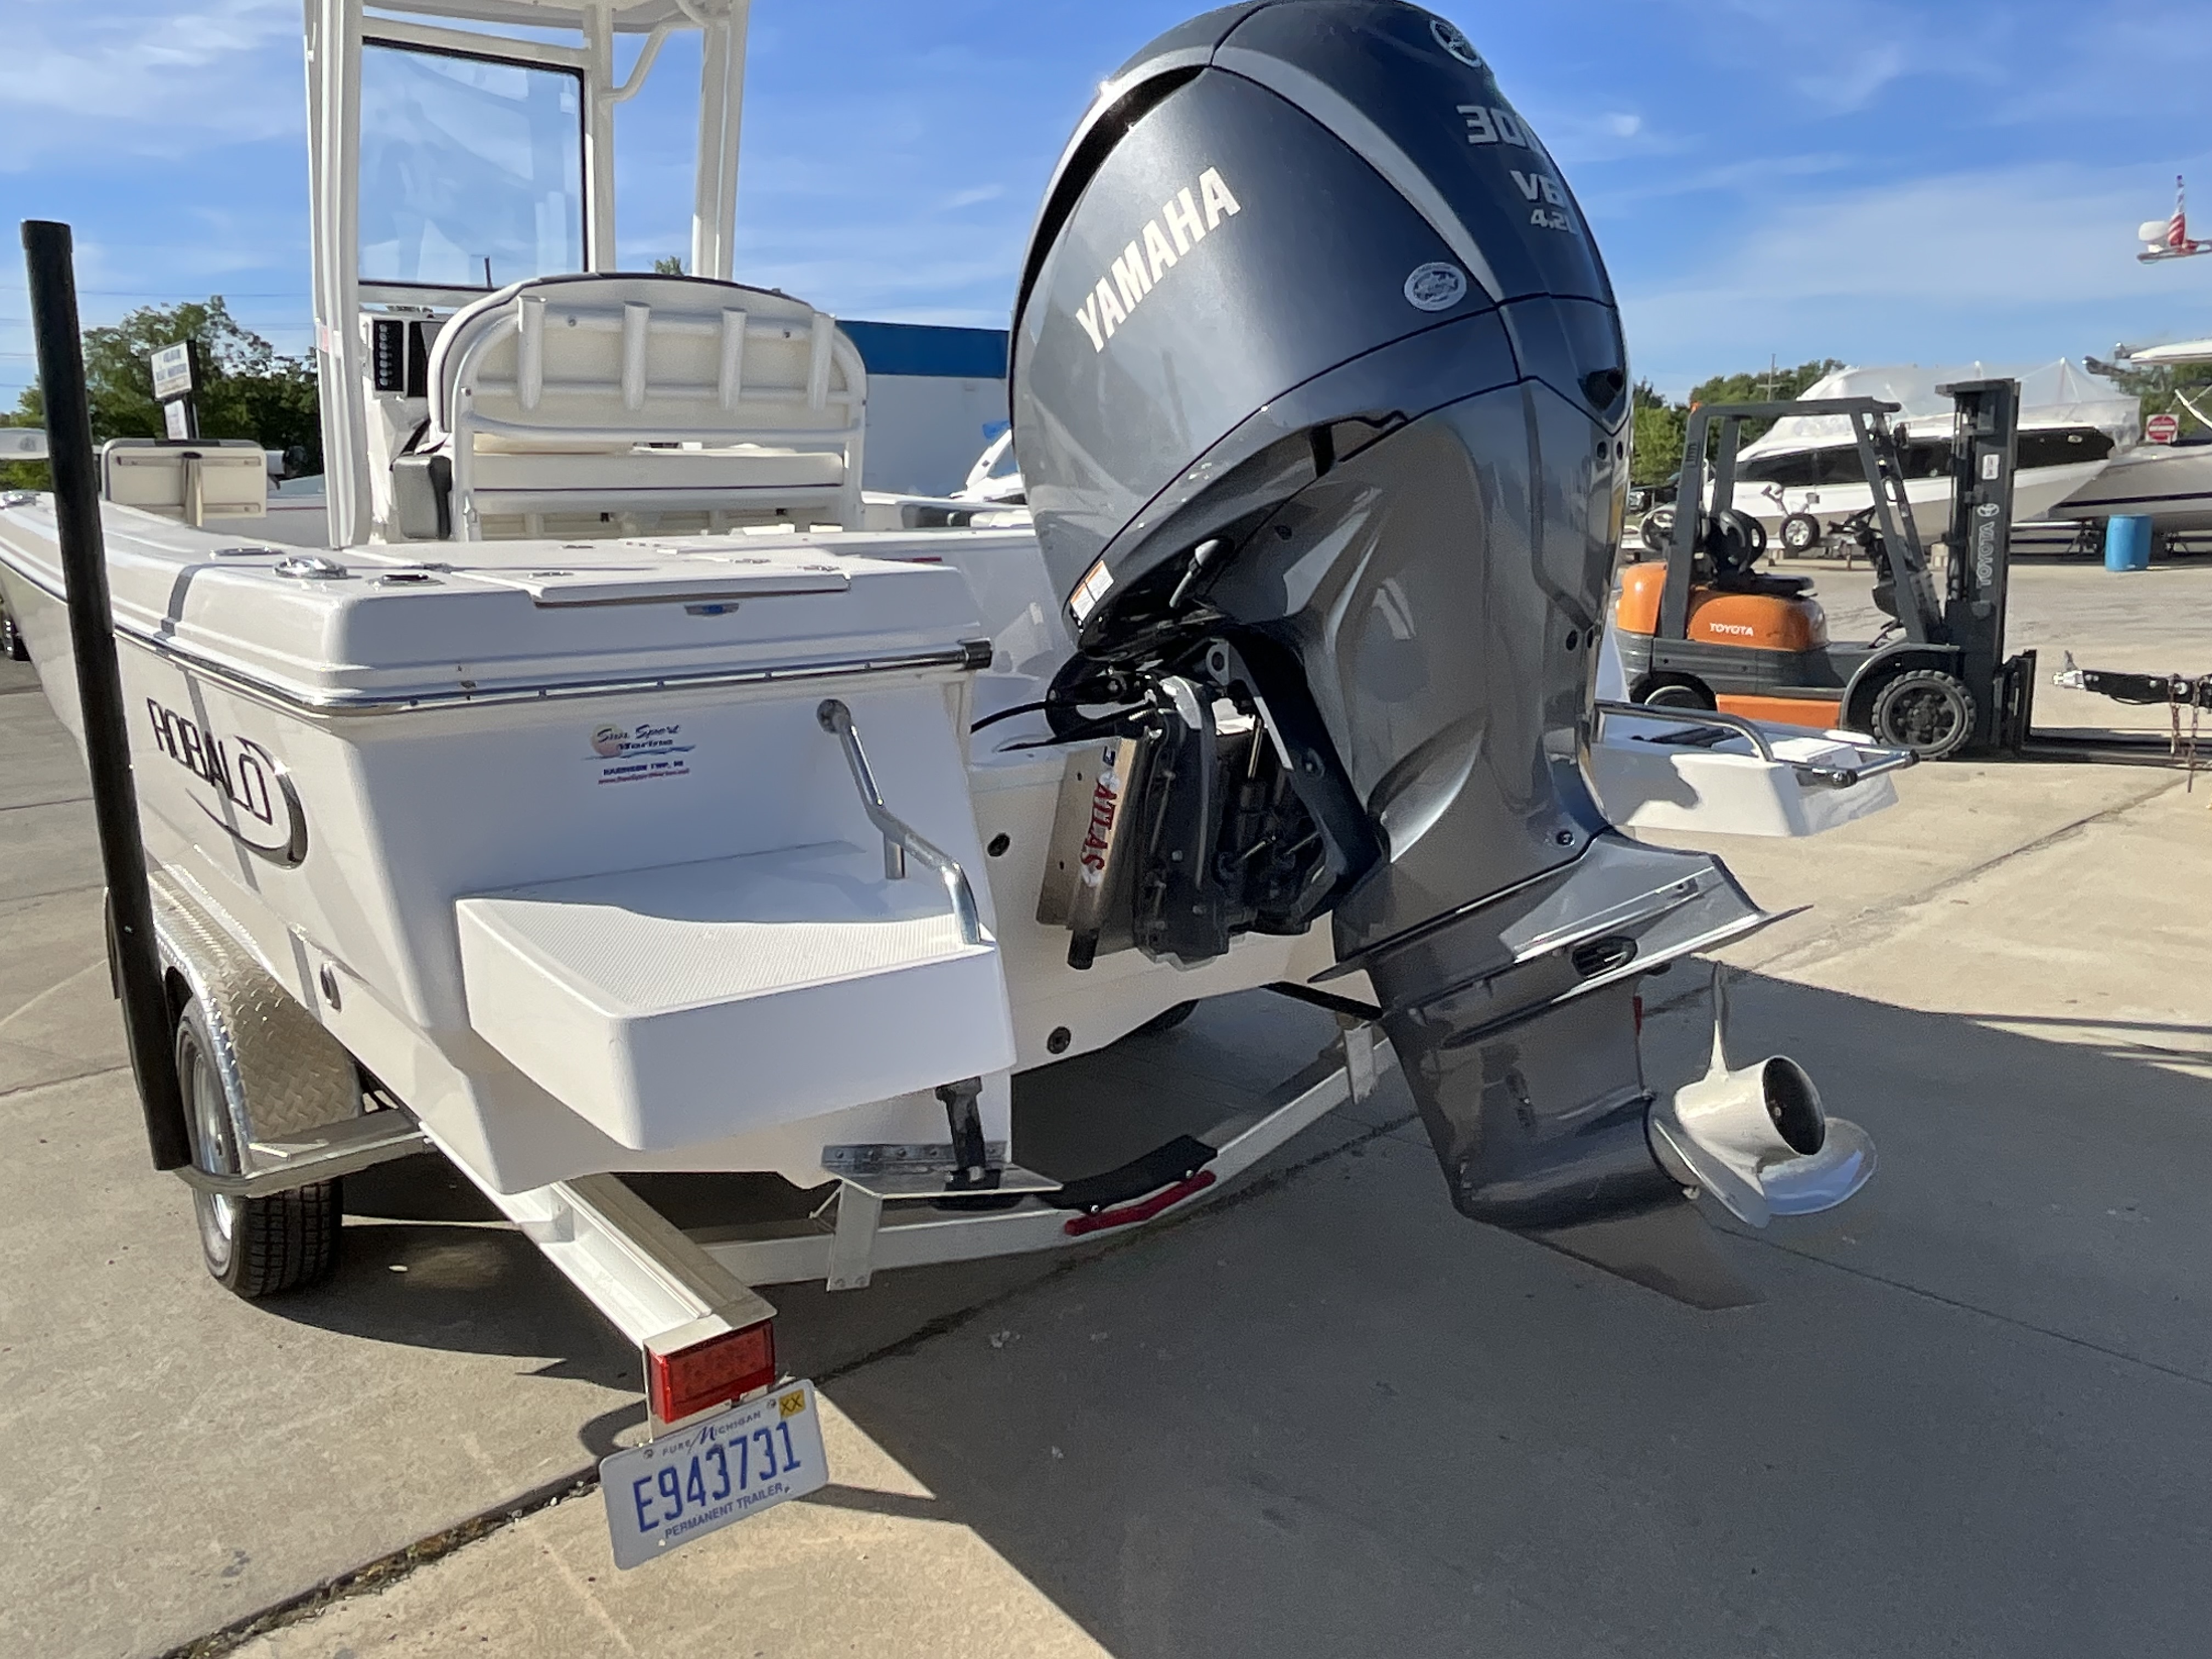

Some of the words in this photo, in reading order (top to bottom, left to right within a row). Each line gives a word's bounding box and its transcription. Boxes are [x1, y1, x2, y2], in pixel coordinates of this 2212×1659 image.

[1510, 170, 1566, 209] V6
[1075, 166, 1241, 353] YAMAHA
[1976, 521, 1994, 589] TOYOTA
[1709, 623, 1753, 636] TOYOTA
[1081, 779, 1118, 870] ATLAS
[781, 1391, 803, 1415] XX
[633, 1421, 801, 1533] E943731
[664, 1502, 733, 1539] PERMANENT
[736, 1482, 783, 1509] TRAILER
